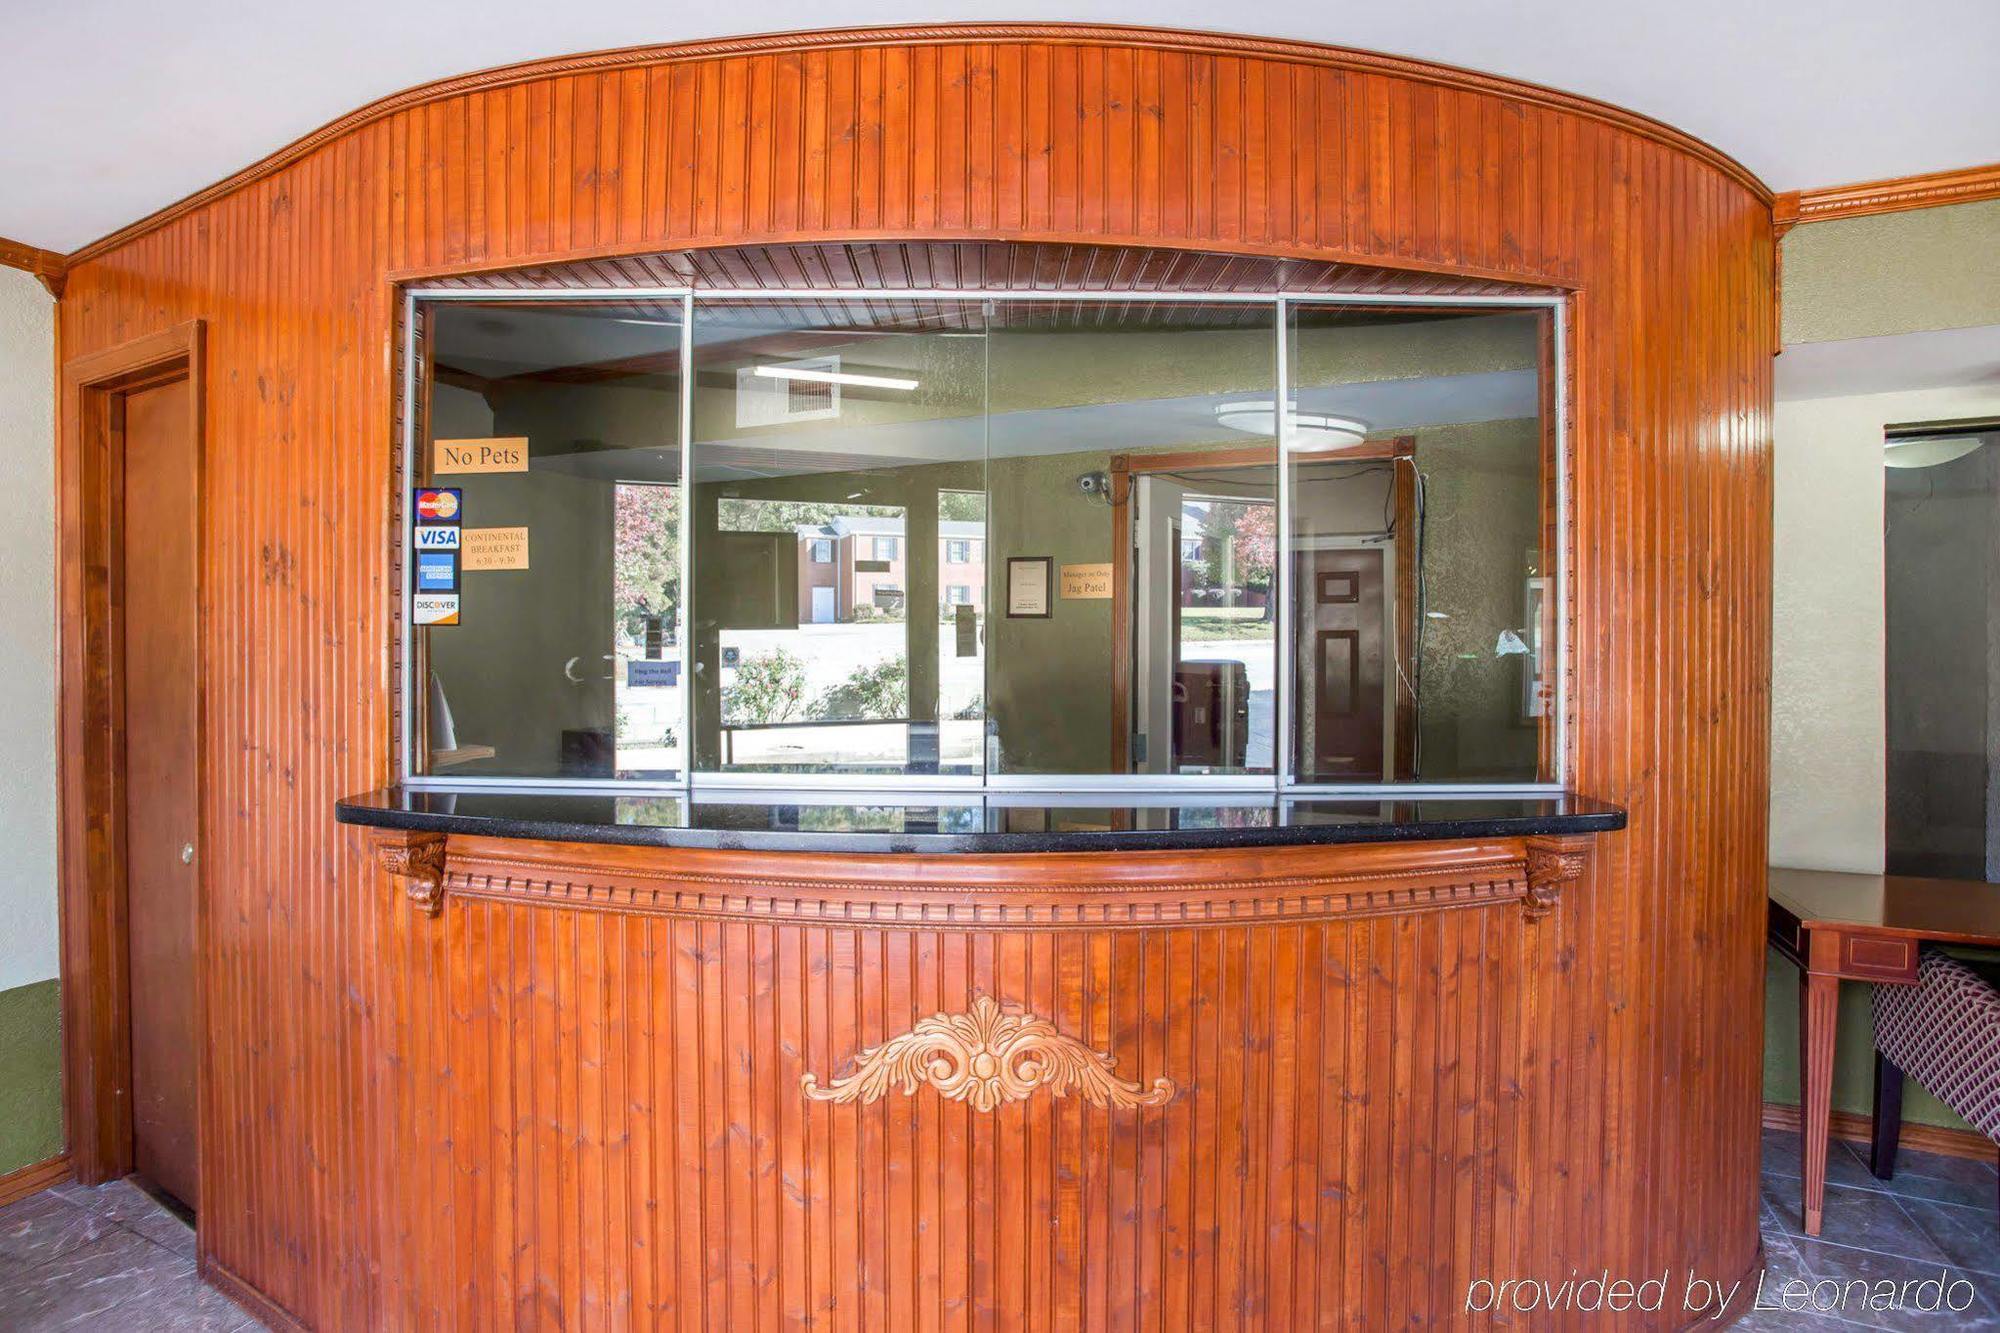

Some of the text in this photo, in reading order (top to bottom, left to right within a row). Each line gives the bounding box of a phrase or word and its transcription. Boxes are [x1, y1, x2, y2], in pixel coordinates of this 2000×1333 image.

[444, 446, 519, 466] No Pets
[418, 501, 458, 510] MasterCard
[420, 530, 457, 544] VISA
[464, 532, 525, 542] CONTINENTAL
[471, 544, 520, 554] BREAKFAST
[1084, 582, 1106, 593] Patel
[416, 600, 456, 609] DISCOVER
